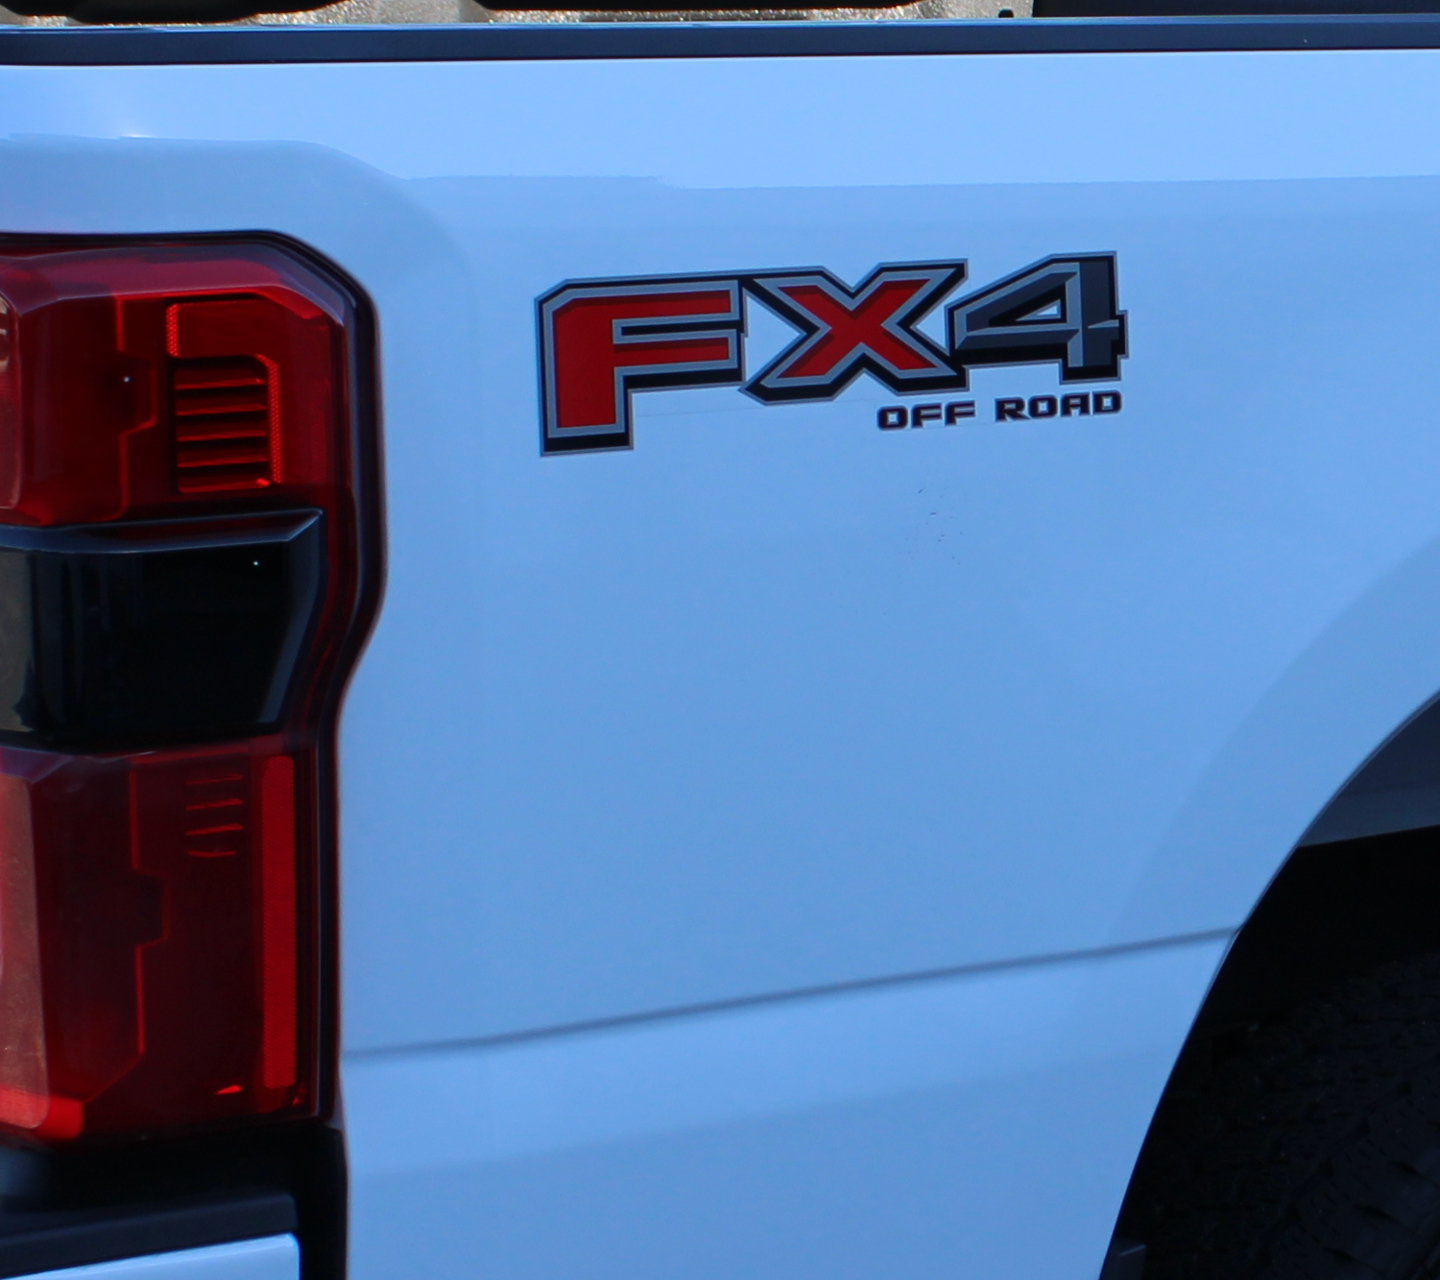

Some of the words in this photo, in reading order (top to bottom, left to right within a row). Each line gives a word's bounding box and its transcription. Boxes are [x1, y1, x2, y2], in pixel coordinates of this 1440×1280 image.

[534, 250, 1129, 458] FX4
[875, 399, 977, 431] OFF
[994, 389, 1123, 423] ROAD
